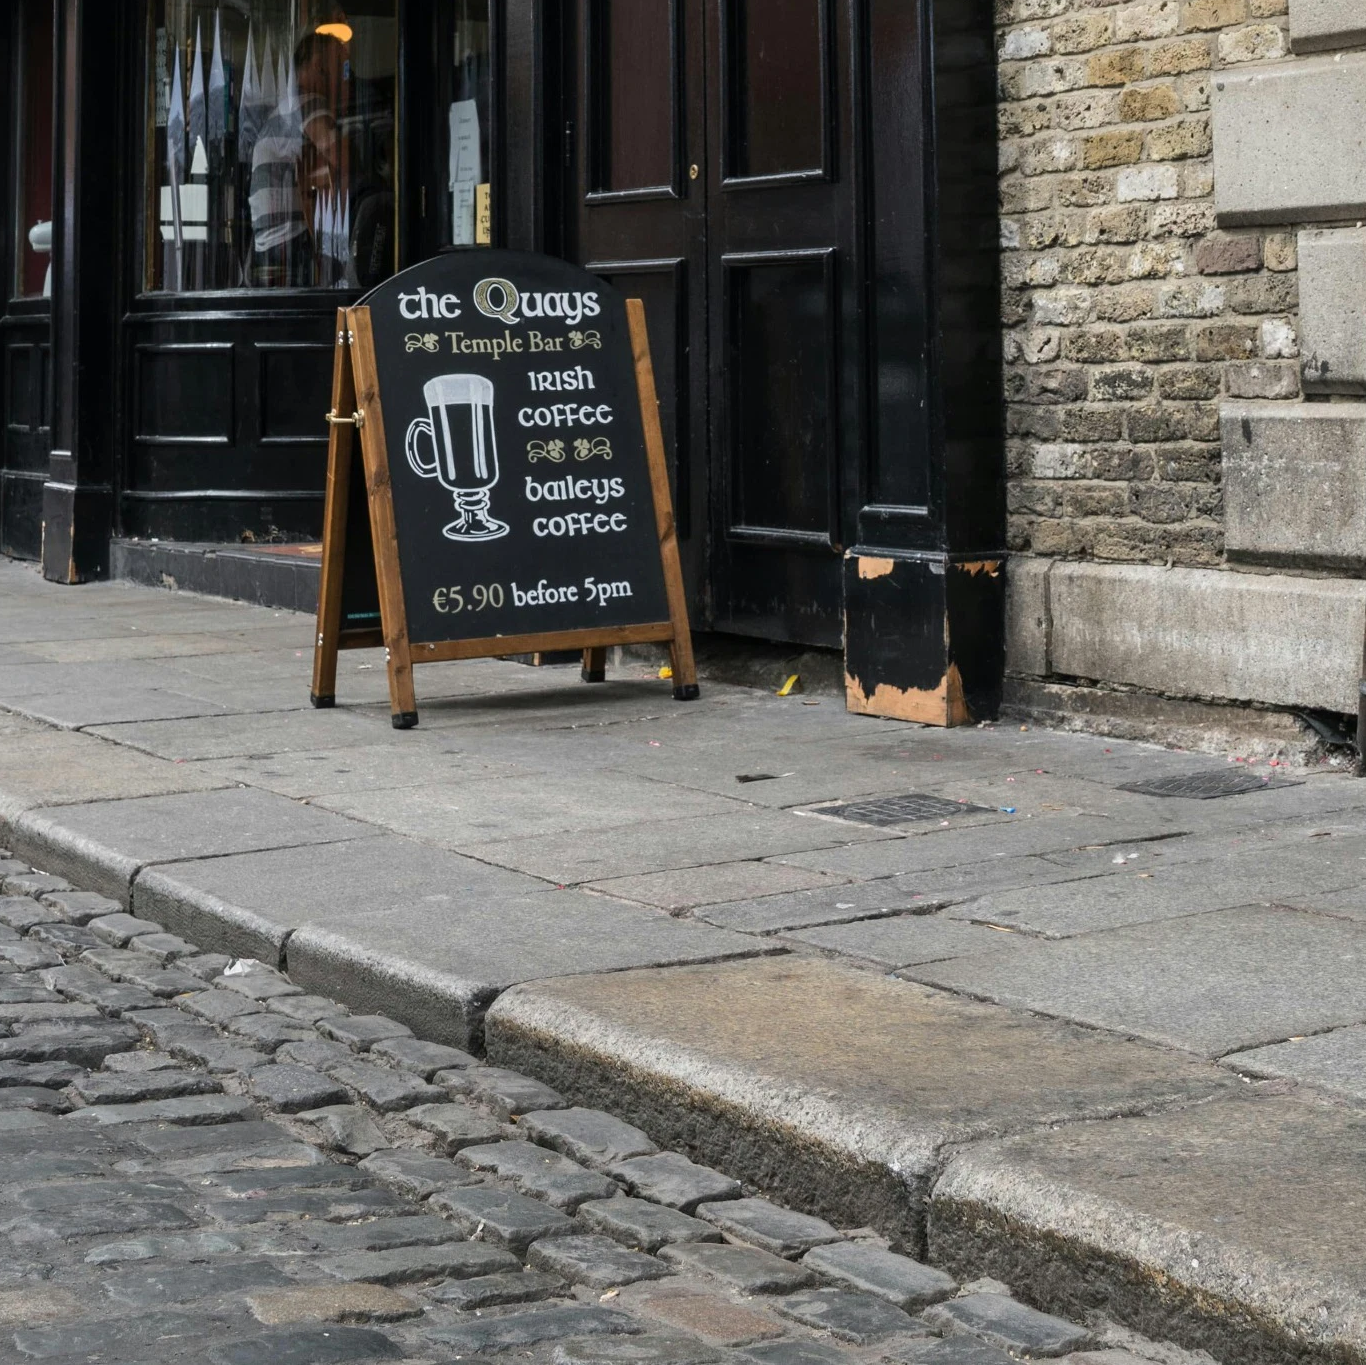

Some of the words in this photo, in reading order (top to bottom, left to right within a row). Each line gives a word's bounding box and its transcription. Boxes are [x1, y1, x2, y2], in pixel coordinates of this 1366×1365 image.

[398, 286, 461, 320] the
[473, 278, 601, 325] Quays
[445, 331, 523, 360] Temple
[529, 332, 564, 353] Bar
[525, 475, 625, 505] baileys
[432, 583, 505, 614] €5.90
[511, 579, 578, 608] before
[584, 577, 634, 607] 5pm
